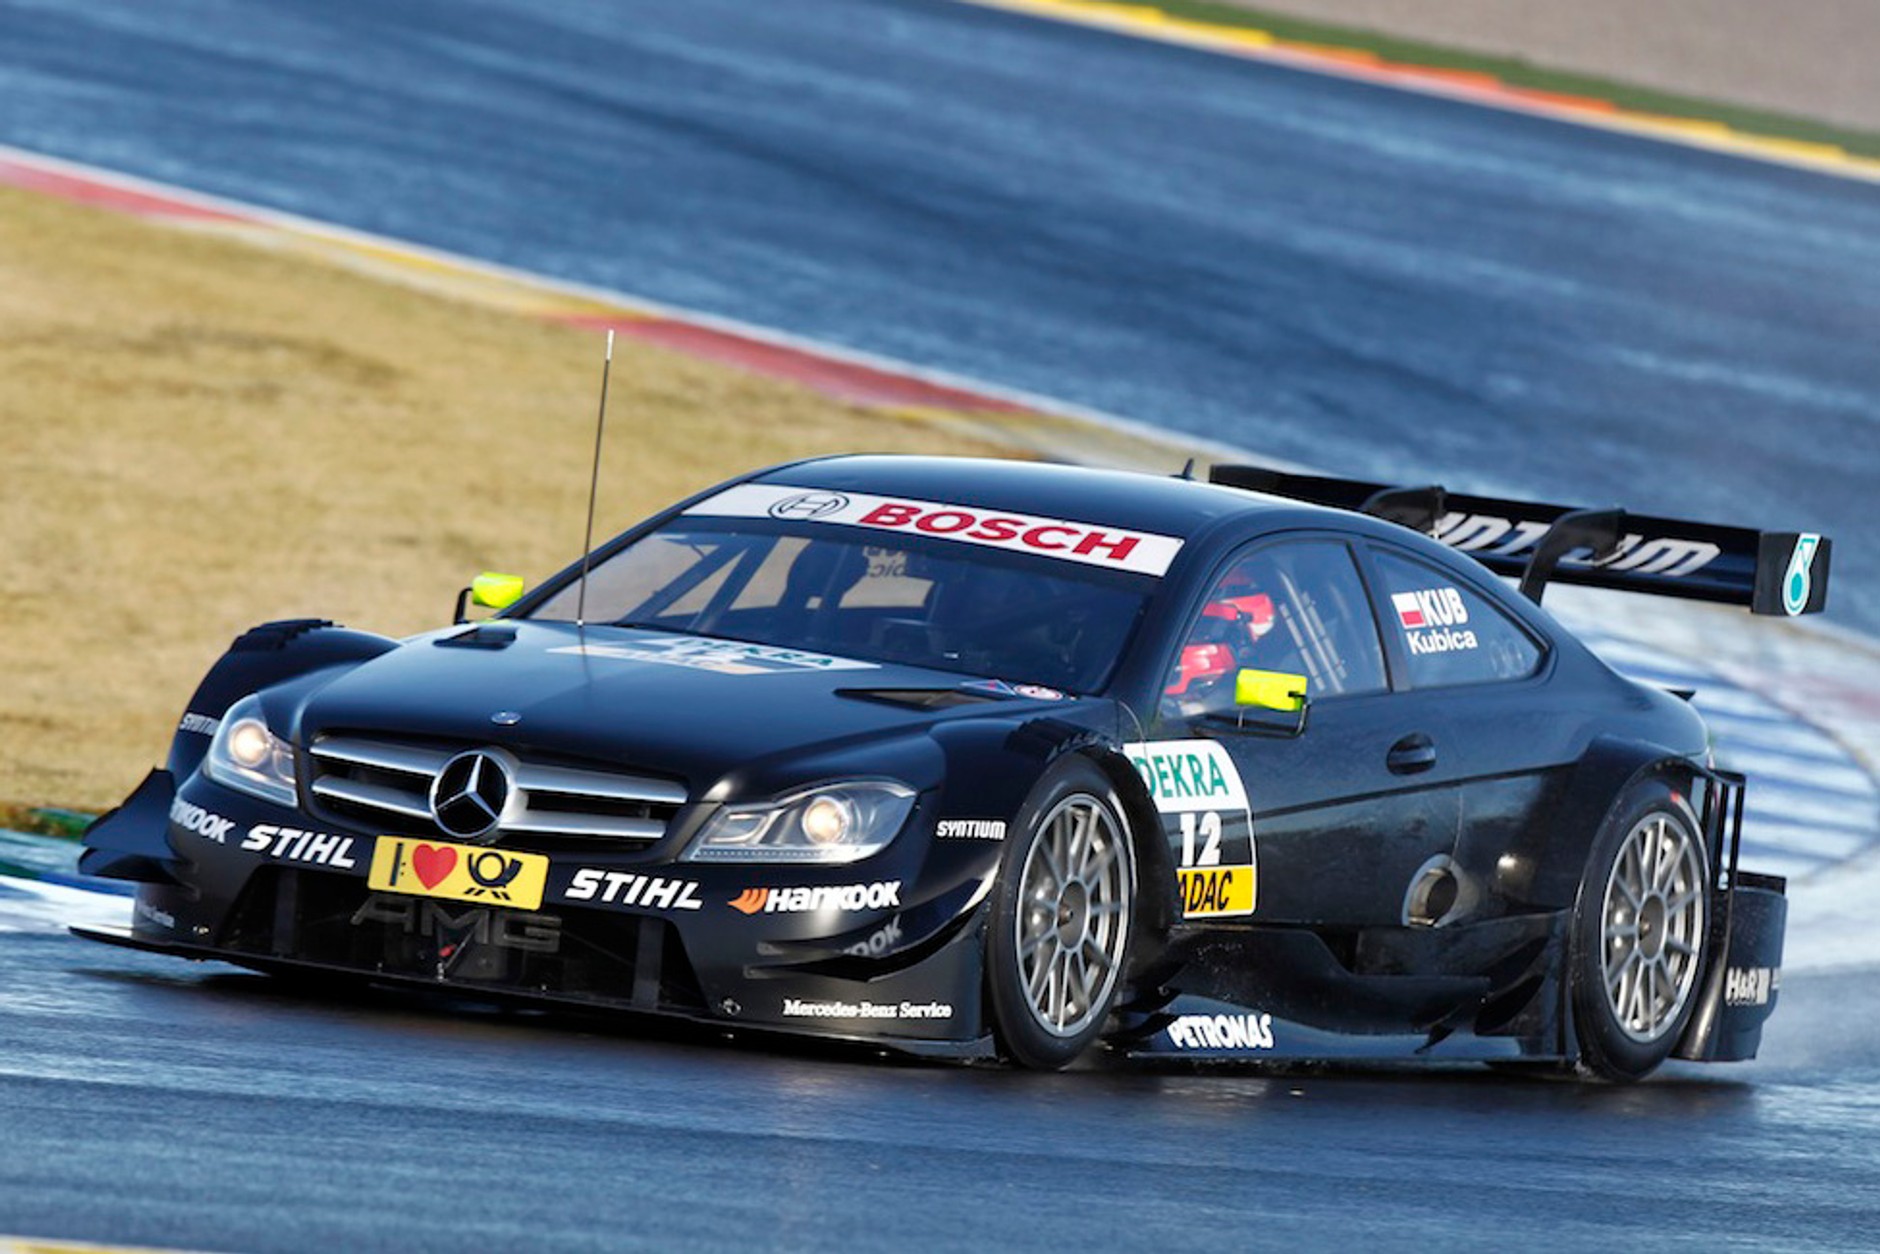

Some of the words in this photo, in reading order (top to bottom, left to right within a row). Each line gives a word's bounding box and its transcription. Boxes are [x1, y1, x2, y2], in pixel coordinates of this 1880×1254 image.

[858, 503, 1141, 561] BOSCH
[1415, 587, 1469, 627] KUB
[1405, 627, 1479, 655] Kubica
[1133, 753, 1230, 798] DEKRA
[240, 824, 356, 869] STIHL
[937, 820, 1006, 840] SYNTIUM
[1179, 810, 1222, 867] 12
[565, 868, 703, 910] STIHL
[350, 893, 563, 953] AMG
[783, 1000, 898, 1018] Mercedes-Benz
[900, 1002, 953, 1018] Service
[1167, 1013, 1274, 1048] PETRONAS
